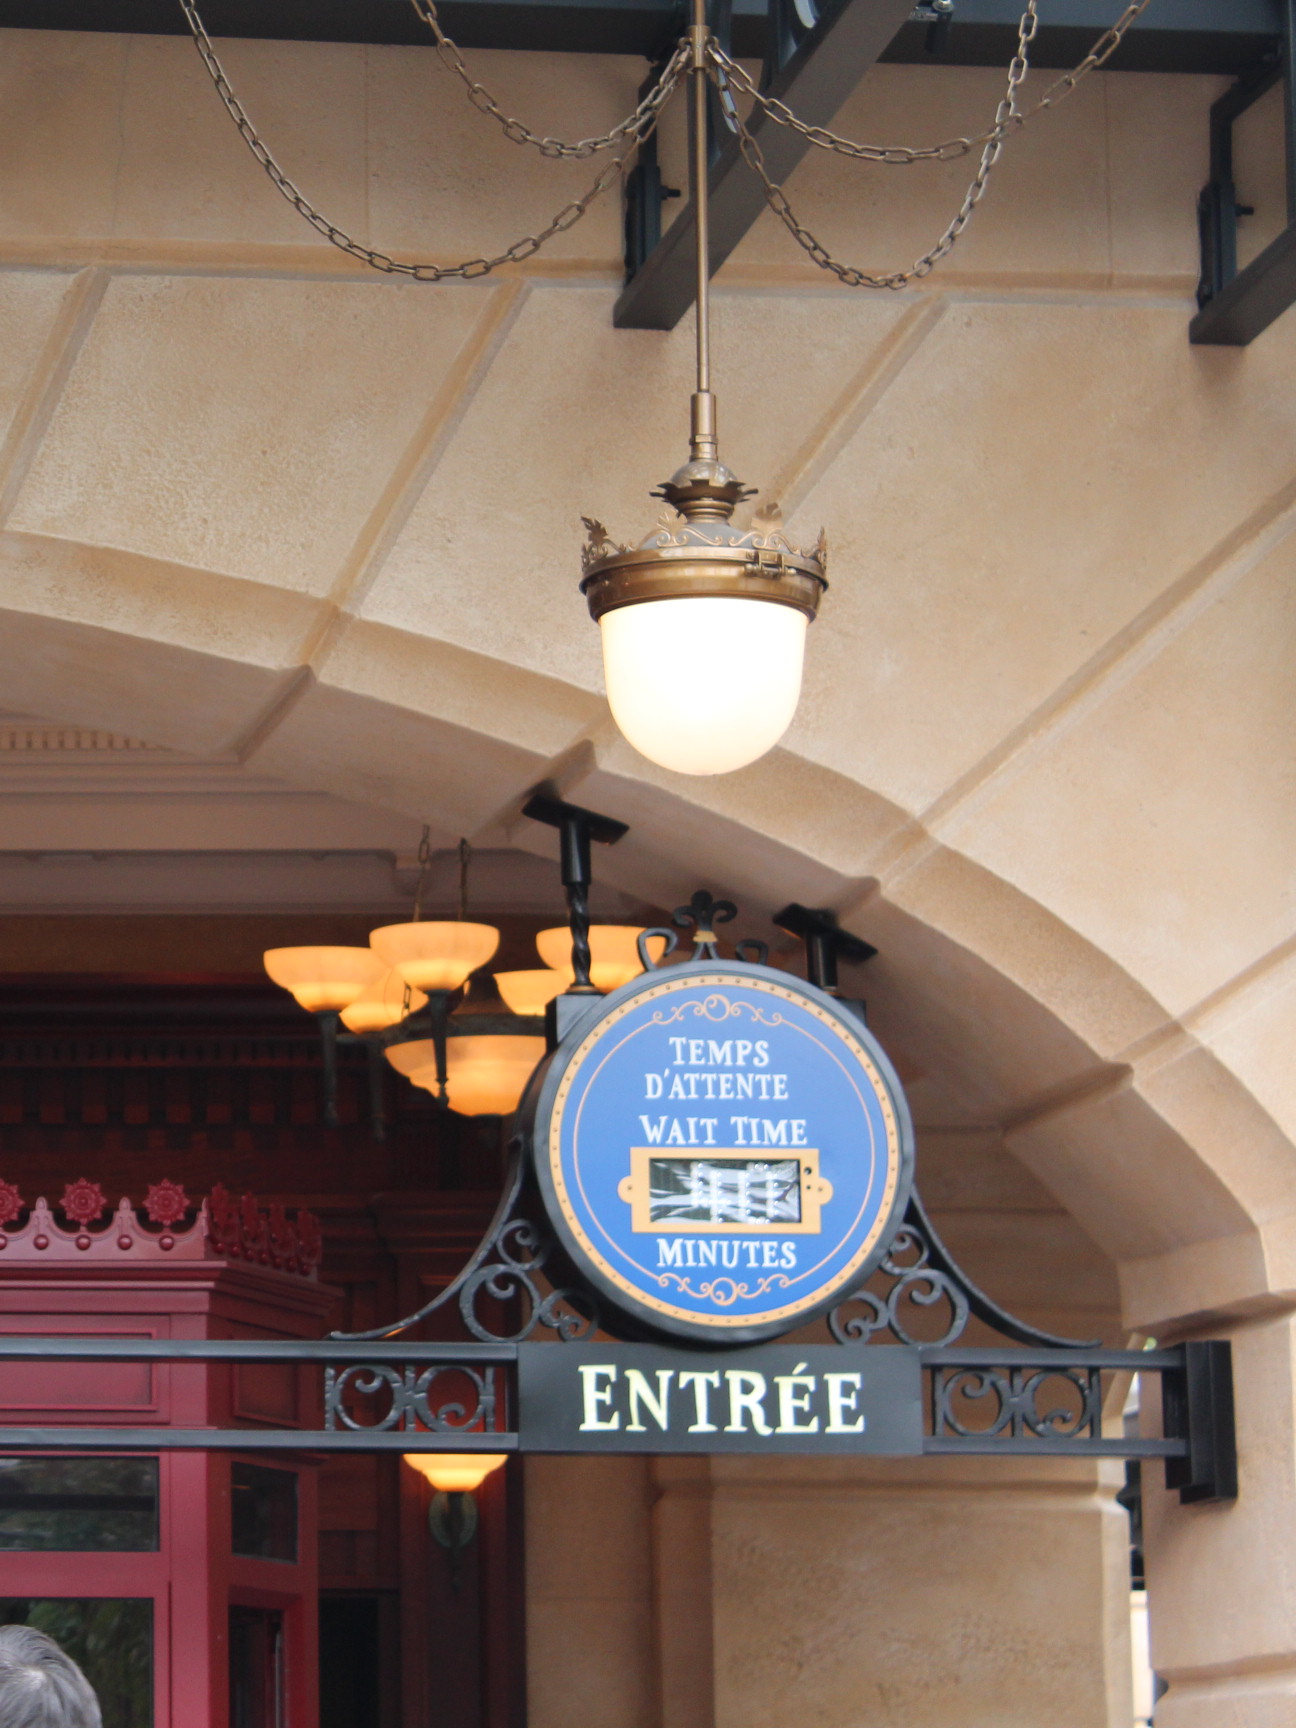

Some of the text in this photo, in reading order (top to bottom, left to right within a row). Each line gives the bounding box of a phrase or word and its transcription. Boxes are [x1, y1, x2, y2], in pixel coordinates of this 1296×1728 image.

[668, 1036, 770, 1067] TEMPS
[644, 1068, 789, 1100] D'ATTENTE
[639, 1114, 808, 1146] WAIT TIME
[656, 1238, 797, 1268] MINUTES
[578, 1361, 865, 1437] ENTRÉE
